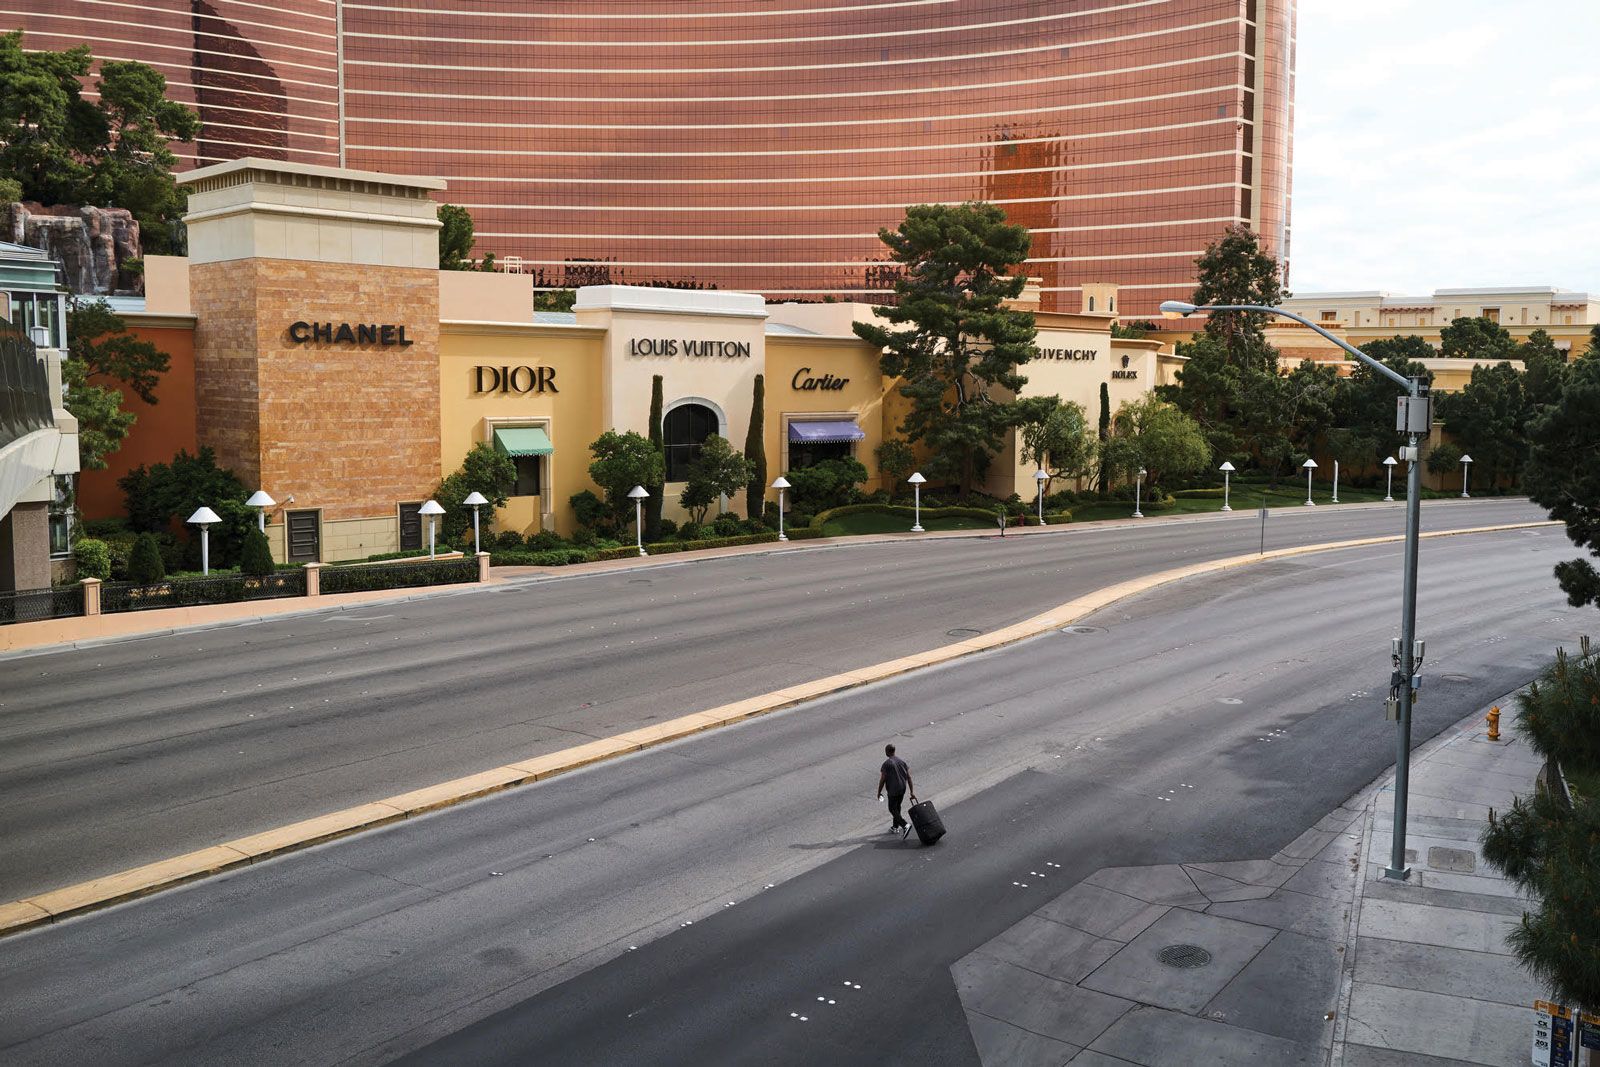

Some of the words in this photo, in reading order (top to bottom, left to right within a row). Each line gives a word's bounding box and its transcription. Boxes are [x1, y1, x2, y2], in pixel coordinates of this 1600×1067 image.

[290, 321, 414, 346] CHANEL
[631, 338, 678, 357] LOUIS
[682, 339, 751, 358] VUITTON
[473, 365, 560, 394] DIOR
[791, 367, 850, 391] Cartier
[1111, 370, 1138, 380] ROLEX
